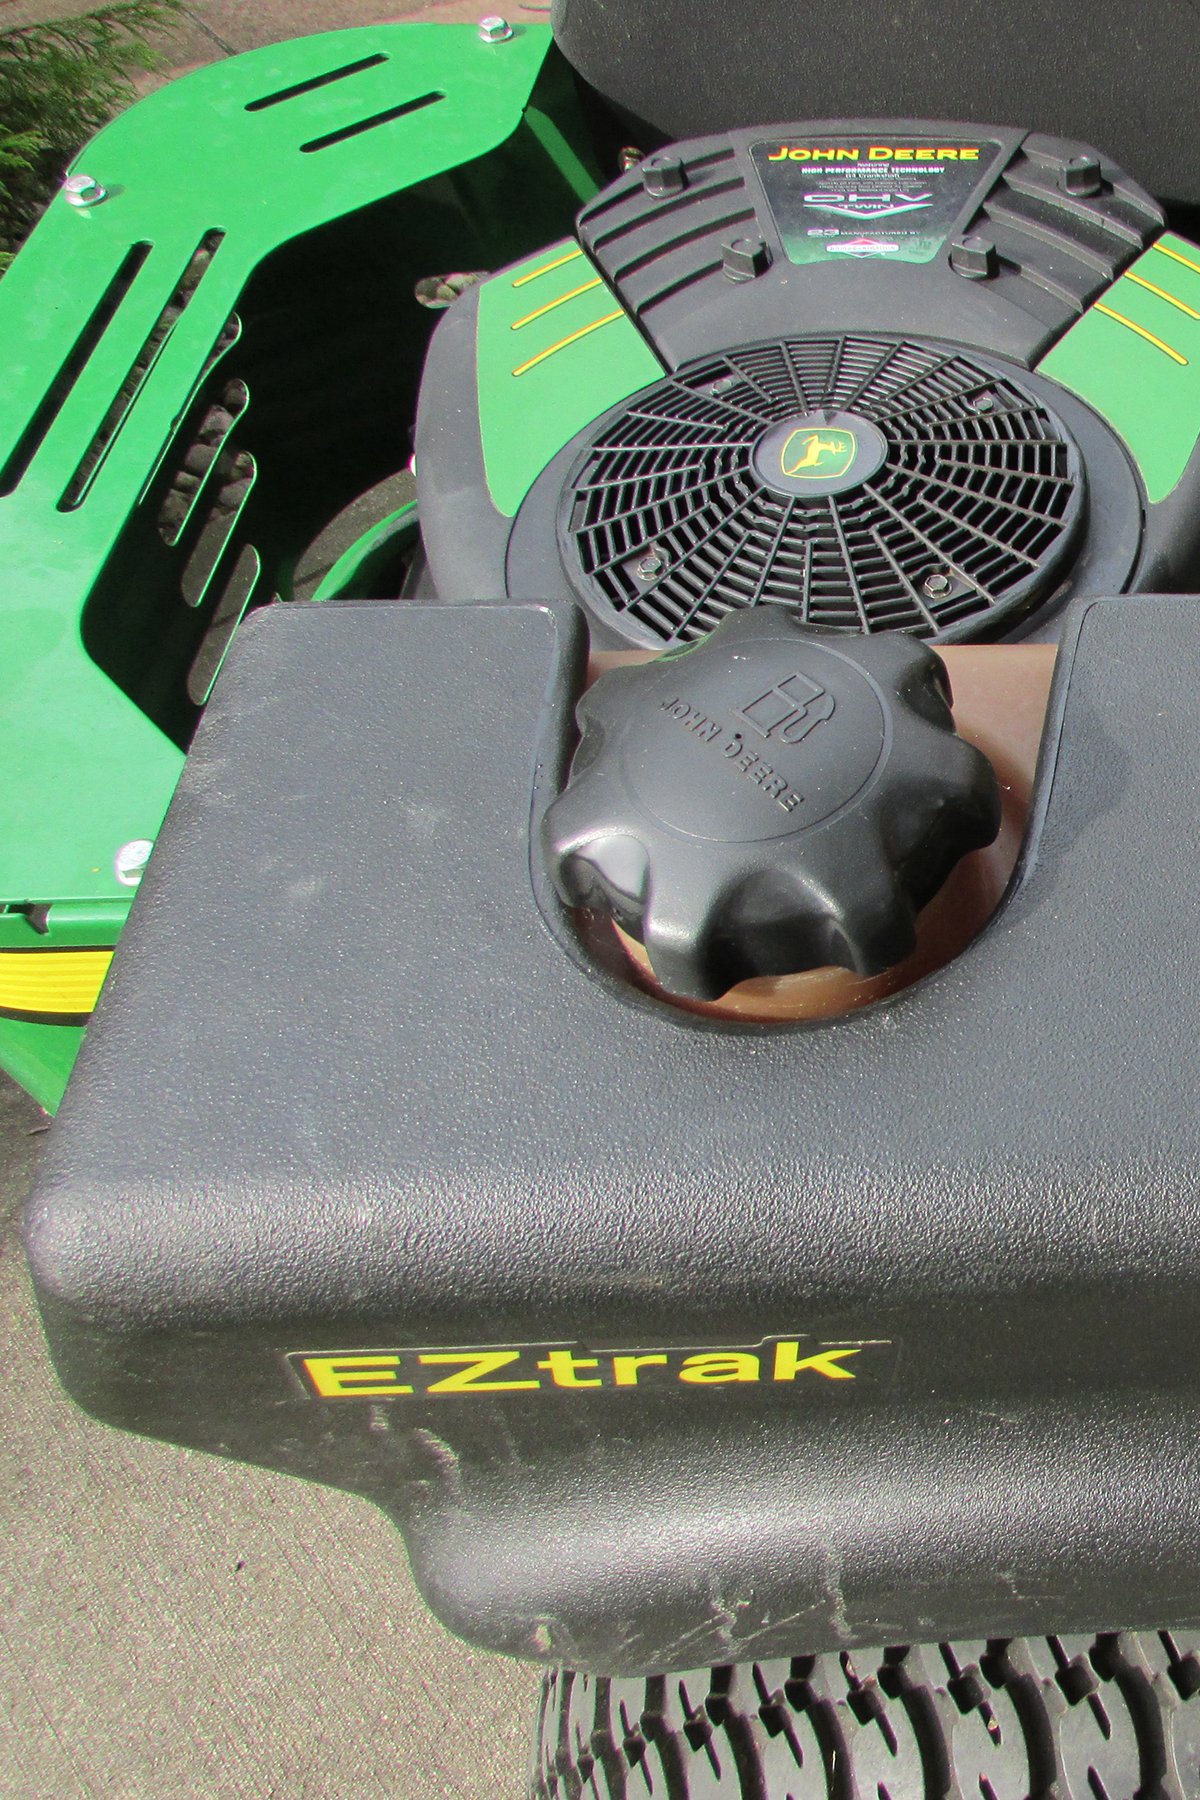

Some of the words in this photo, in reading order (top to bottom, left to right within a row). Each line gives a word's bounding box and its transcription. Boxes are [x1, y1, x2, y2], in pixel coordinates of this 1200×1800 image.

[768, 146, 860, 161] JOHN
[868, 146, 980, 161] DEERE
[803, 193, 933, 202] OHV
[658, 698, 723, 742] JOHN
[723, 738, 804, 813] DEERE
[302, 1341, 862, 1398] EZtrak
